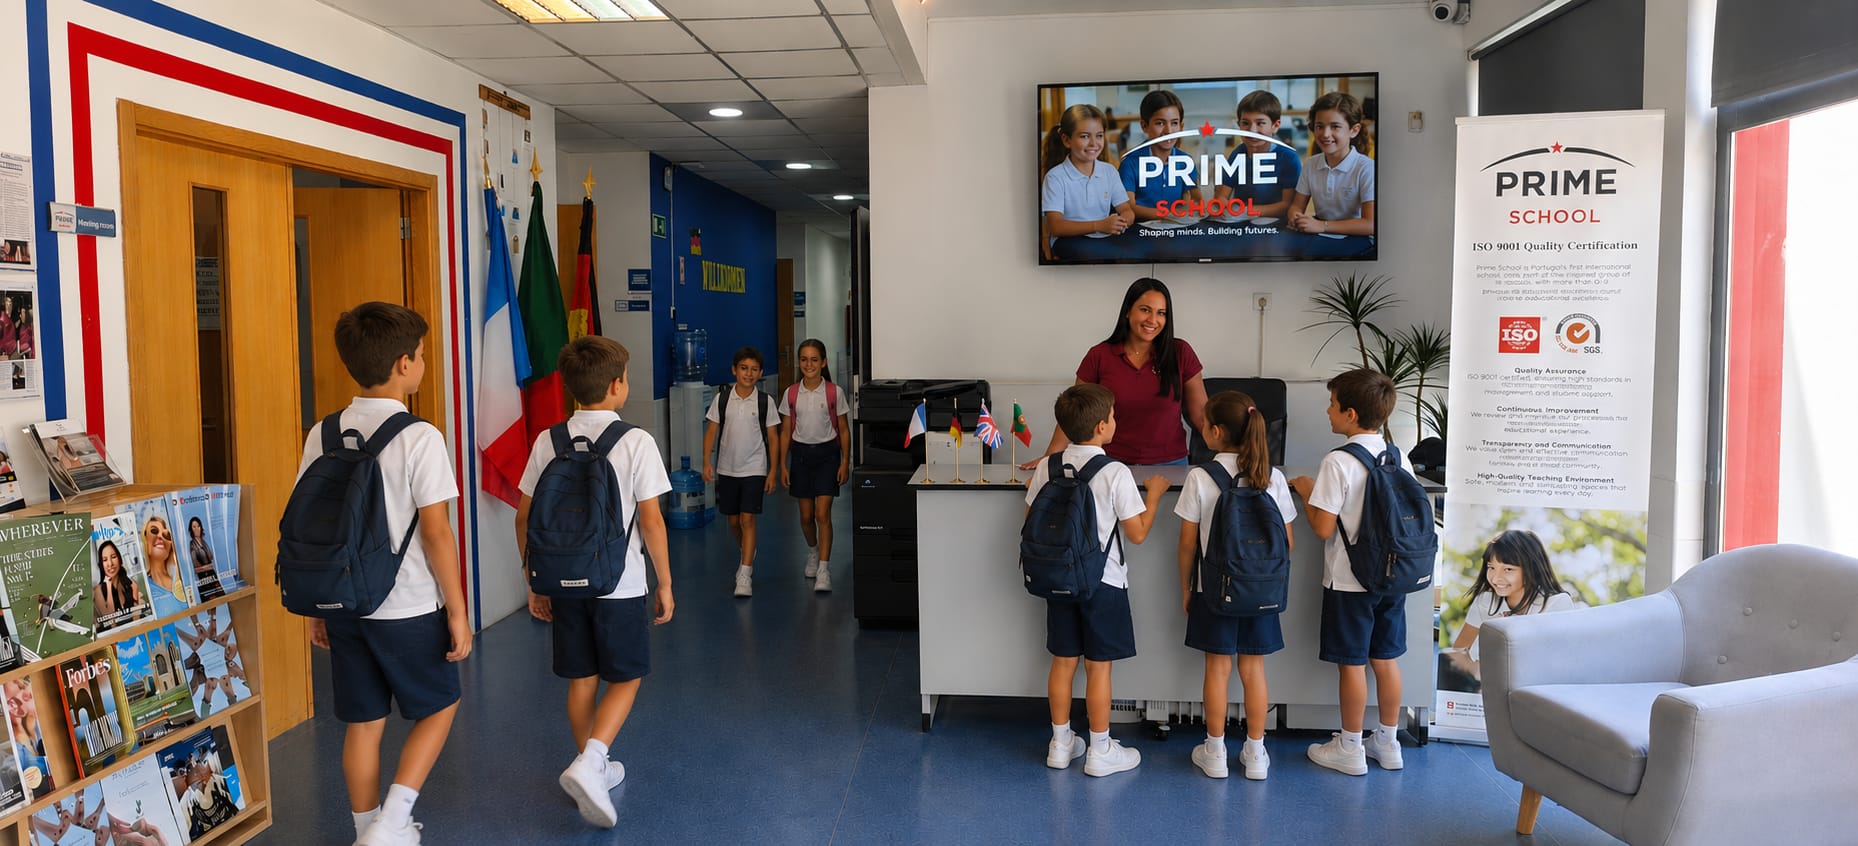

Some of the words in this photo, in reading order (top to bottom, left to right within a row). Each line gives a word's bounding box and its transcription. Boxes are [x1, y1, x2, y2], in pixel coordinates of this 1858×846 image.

[1138, 152, 1278, 188] PRIME
[1496, 169, 1617, 197] PRIME
[1156, 197, 1261, 218] SCHOOL
[1509, 209, 1600, 224] SCHOOL
[1139, 229, 1175, 237] Shaping
[1176, 228, 1205, 236] minds.
[1207, 227, 1242, 236] Building
[1245, 226, 1279, 234] futures.
[1472, 243, 1492, 251] ISO
[1496, 243, 1520, 251] 9001
[1524, 242, 1564, 252] Quality
[1567, 241, 1638, 250] Certification
[1501, 328, 1538, 342] ISO
[1477, 472, 1524, 481] High-Quality
[0, 518, 84, 542] WHEREVER
[66, 659, 111, 688] Forbes
